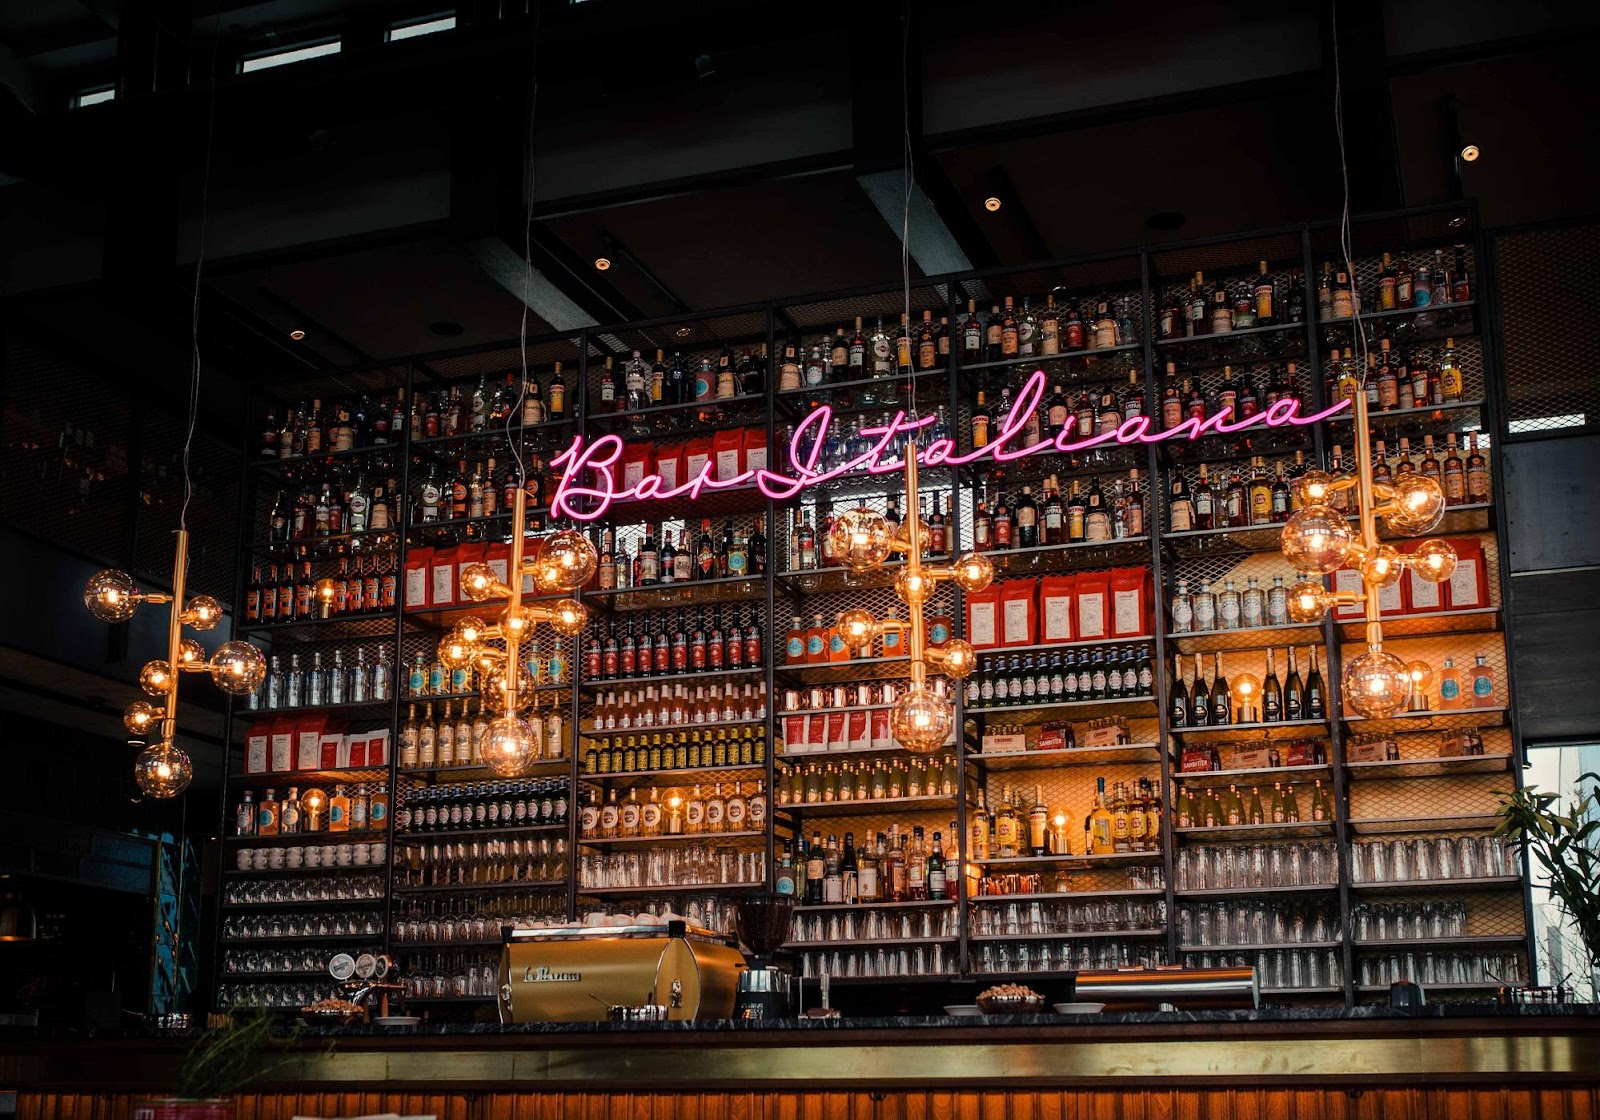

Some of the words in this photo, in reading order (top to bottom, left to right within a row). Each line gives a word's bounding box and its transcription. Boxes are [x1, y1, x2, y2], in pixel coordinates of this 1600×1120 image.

[550, 433, 755, 520] Bar
[756, 369, 1353, 499] Italiana
[1183, 759, 1208, 769] SANBITTER
